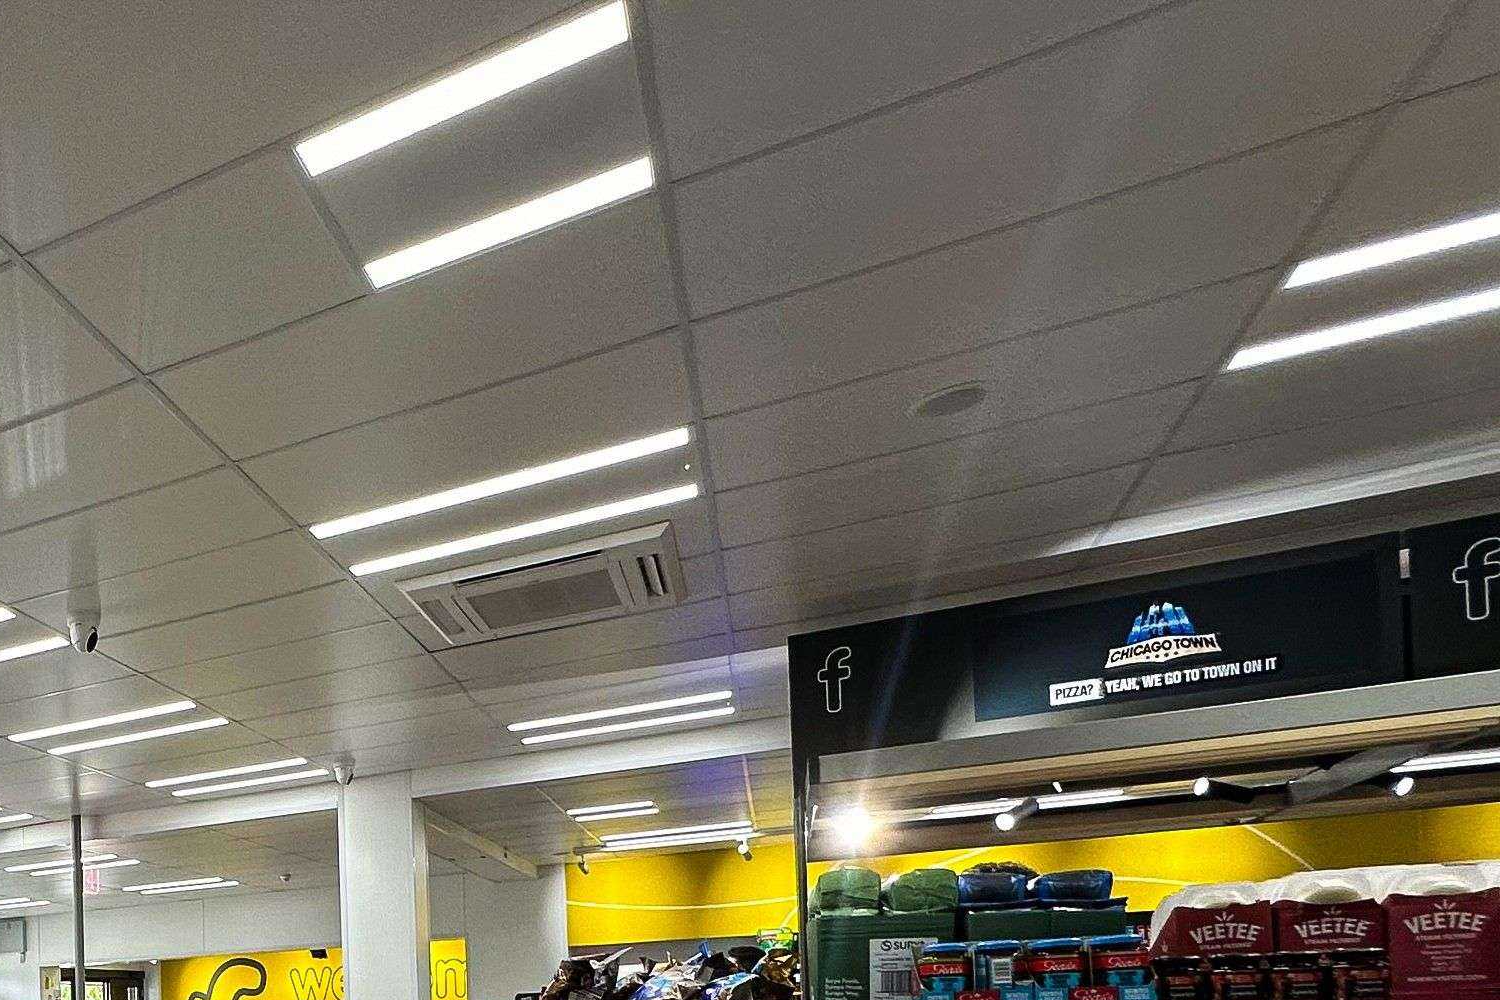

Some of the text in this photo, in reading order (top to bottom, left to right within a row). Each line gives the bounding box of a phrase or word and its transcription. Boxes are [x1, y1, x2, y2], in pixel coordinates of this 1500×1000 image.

[1111, 636, 1217, 662] CHICAGO TOWN
[1055, 657, 1277, 700] PIZZA? YEAH, WE GO TO TOWN ON IT
[1189, 922, 1262, 944] VEETEE
[1294, 917, 1371, 938] VEETEE
[1403, 911, 1488, 934] VEETEE
